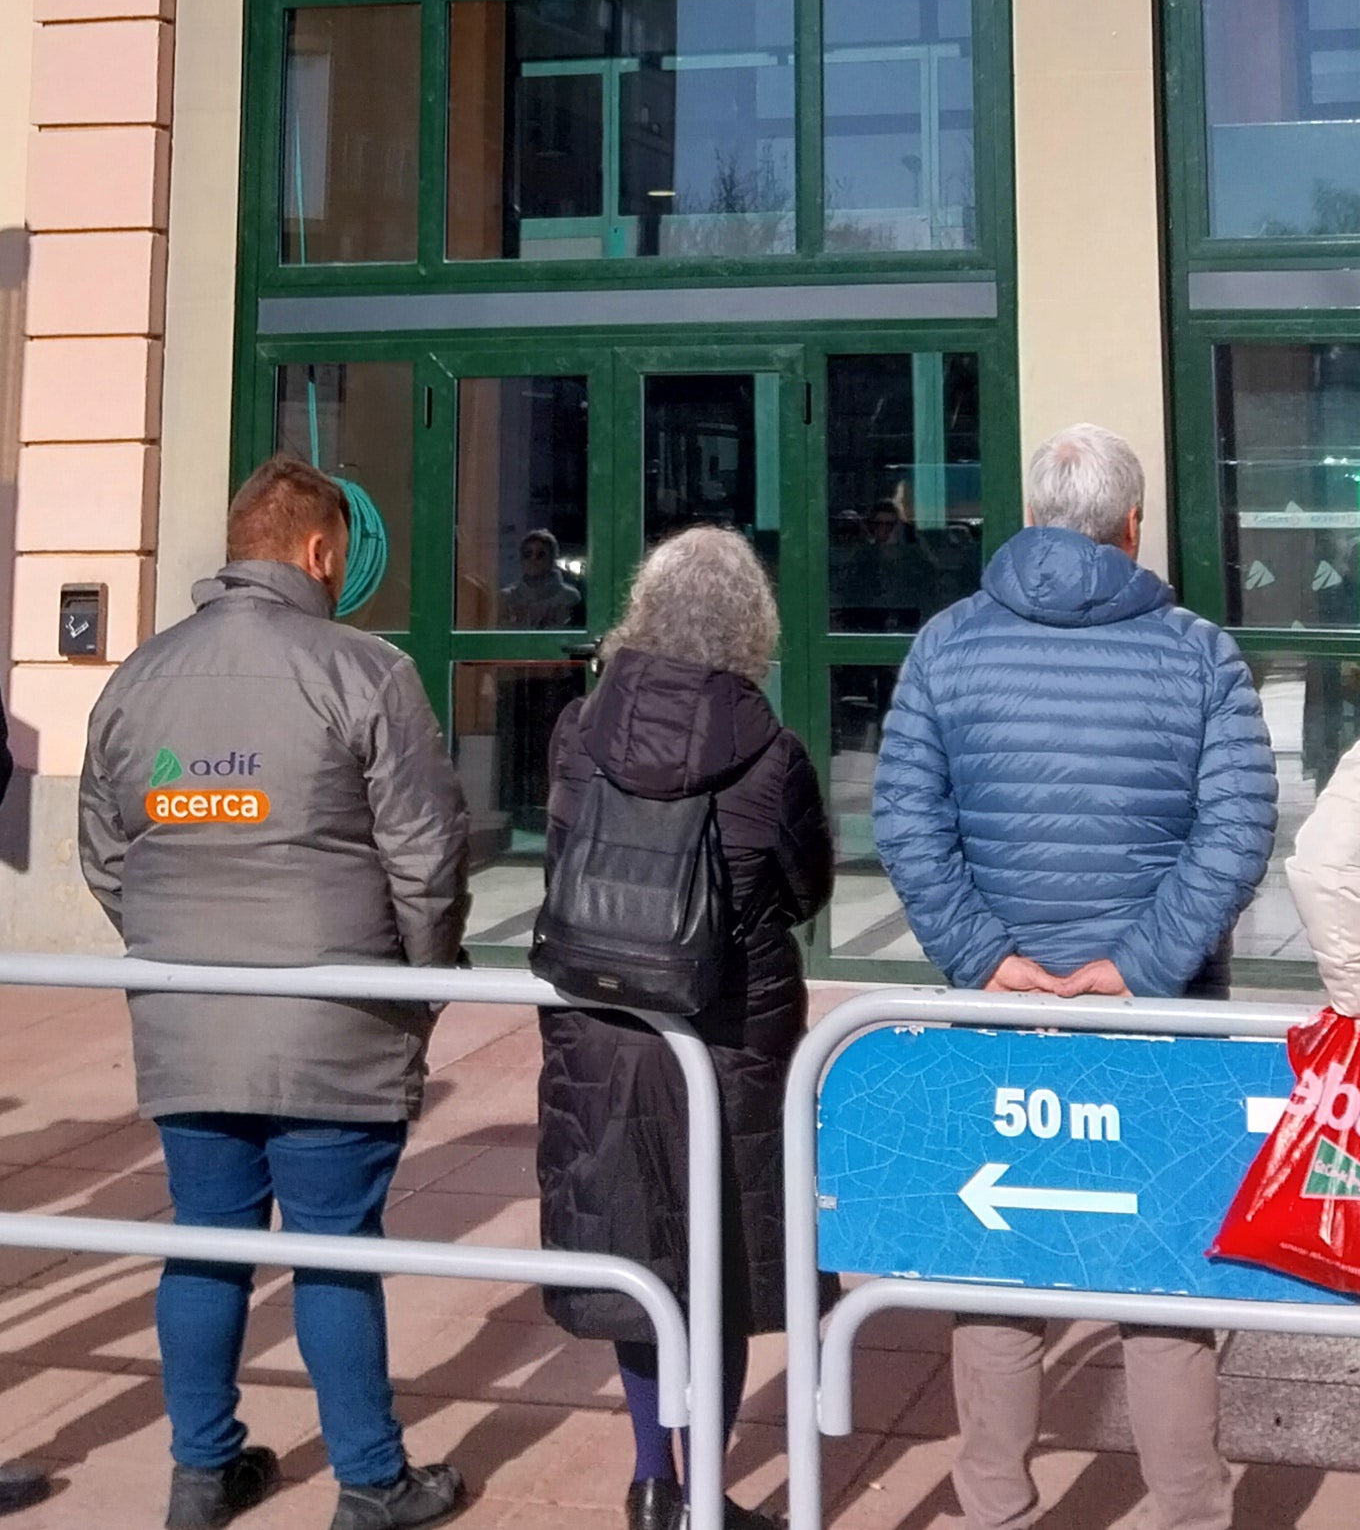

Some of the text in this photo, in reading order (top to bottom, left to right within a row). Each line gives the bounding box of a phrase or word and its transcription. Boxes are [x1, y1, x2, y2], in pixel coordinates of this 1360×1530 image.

[189, 751, 263, 776] adif
[156, 794, 259, 818] acerca
[993, 1087, 1121, 1141] 50 m
